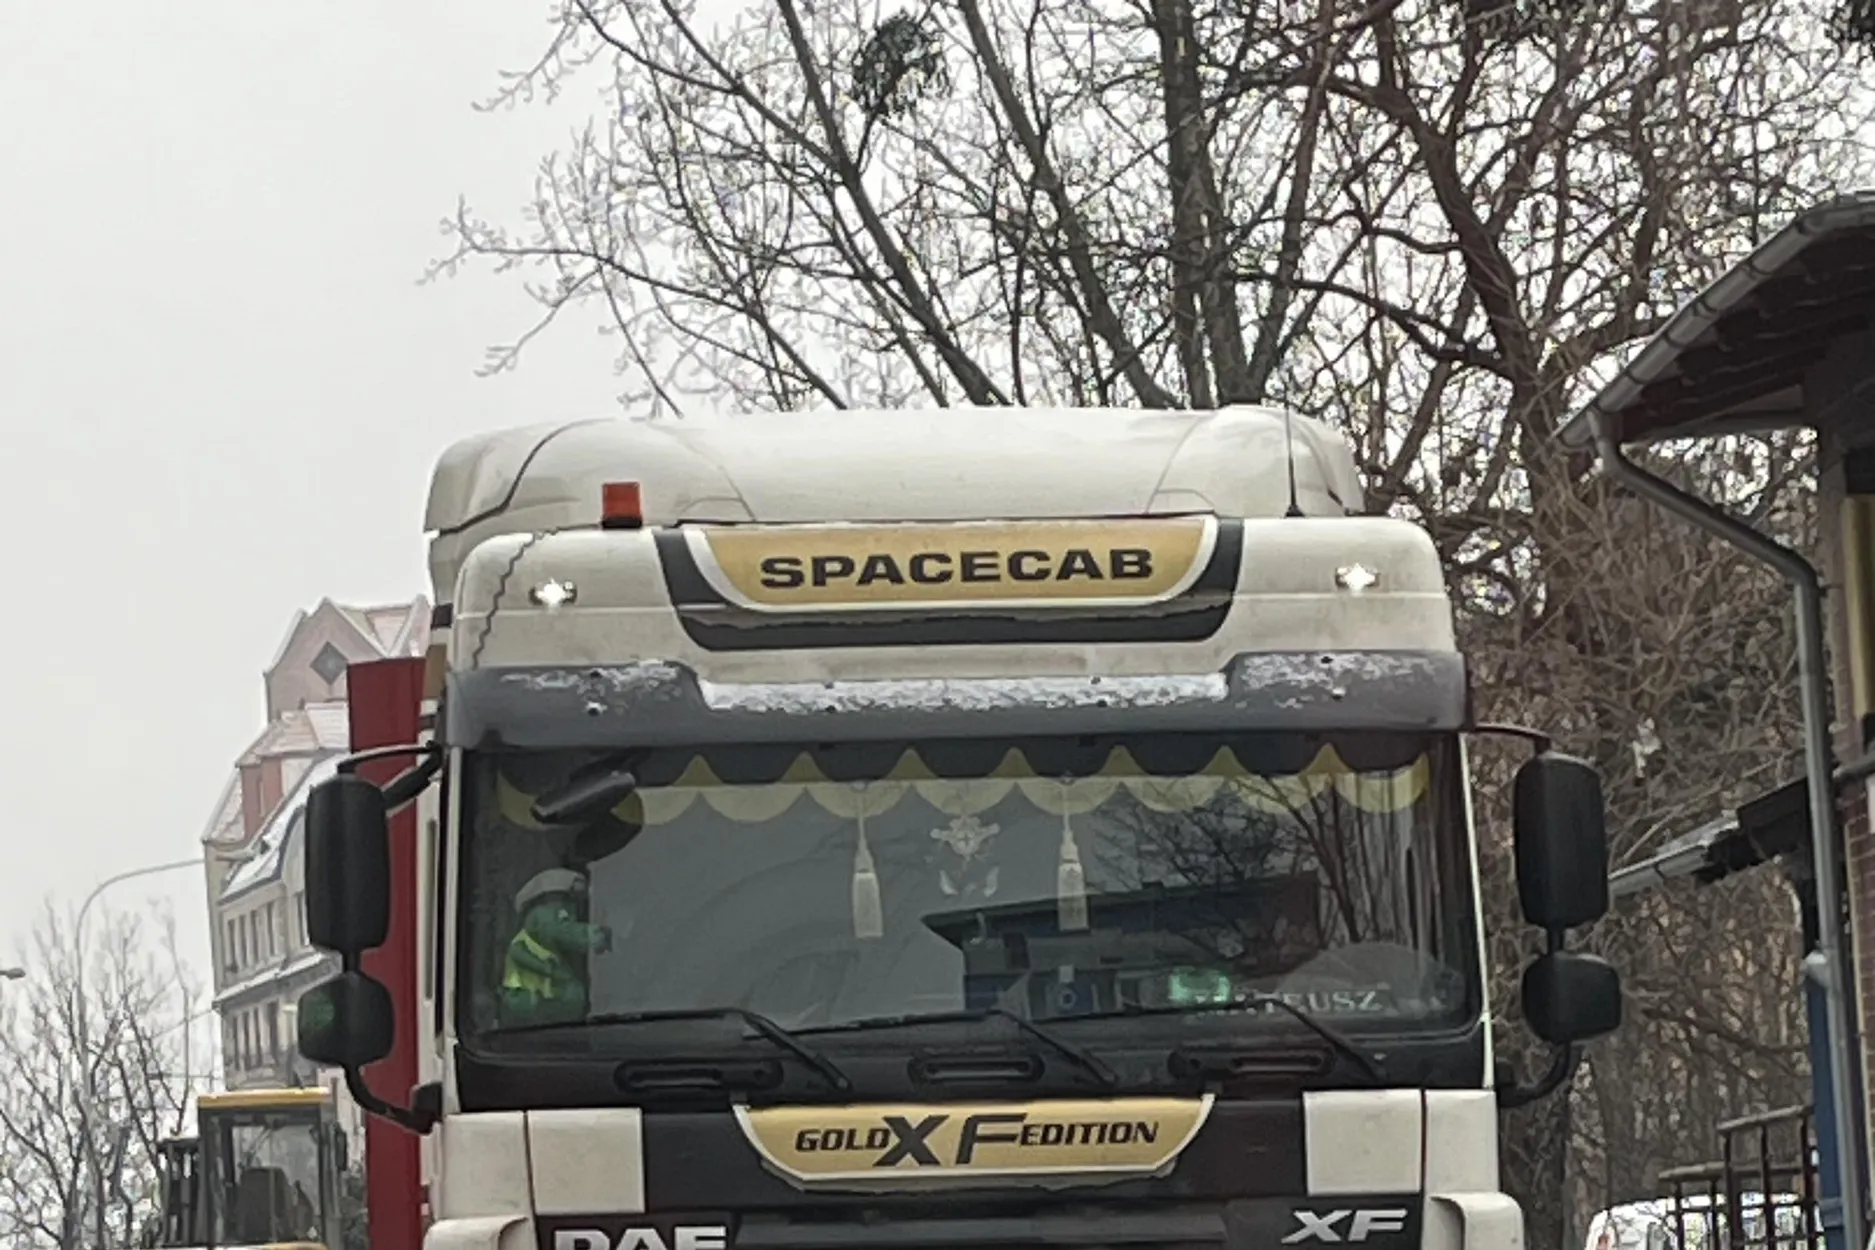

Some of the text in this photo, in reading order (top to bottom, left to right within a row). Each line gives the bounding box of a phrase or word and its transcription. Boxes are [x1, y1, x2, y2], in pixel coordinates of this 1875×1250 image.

[760, 547, 1153, 588] SPACECAB
[795, 1112, 1160, 1167] GOLD XF EDITION
[1280, 1207, 1408, 1244] XF
